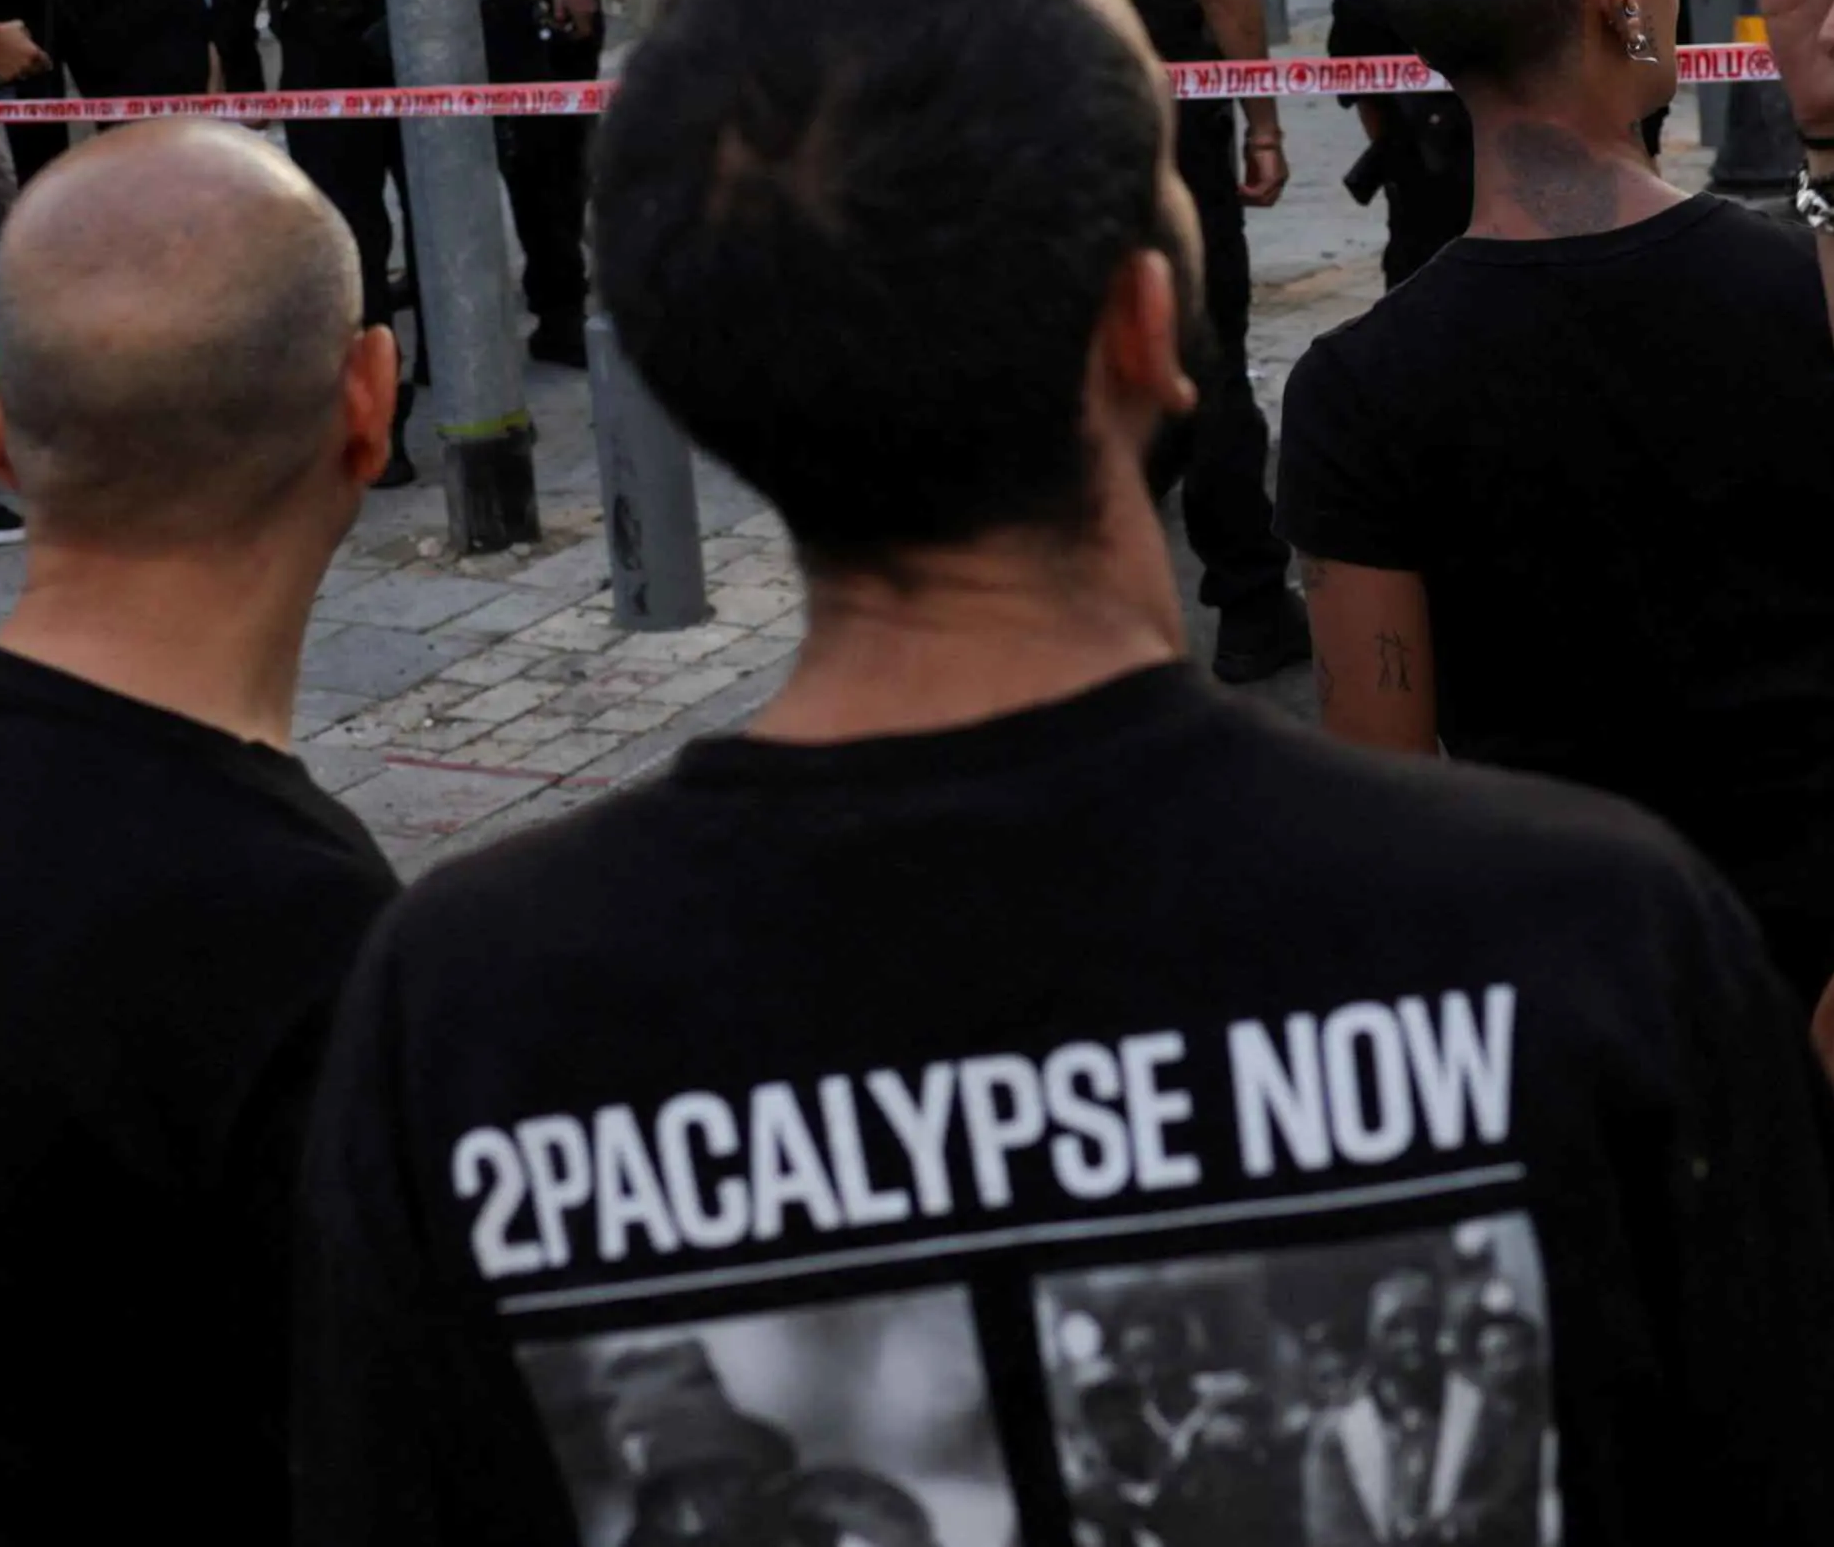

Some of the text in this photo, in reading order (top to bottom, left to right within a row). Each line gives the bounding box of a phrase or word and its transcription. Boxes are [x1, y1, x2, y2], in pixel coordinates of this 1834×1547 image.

[1319, 62, 1401, 91] משטרת
[1677, 49, 1743, 79] שטרת
[452, 981, 1518, 1282] 2PACALYPSE NOW
